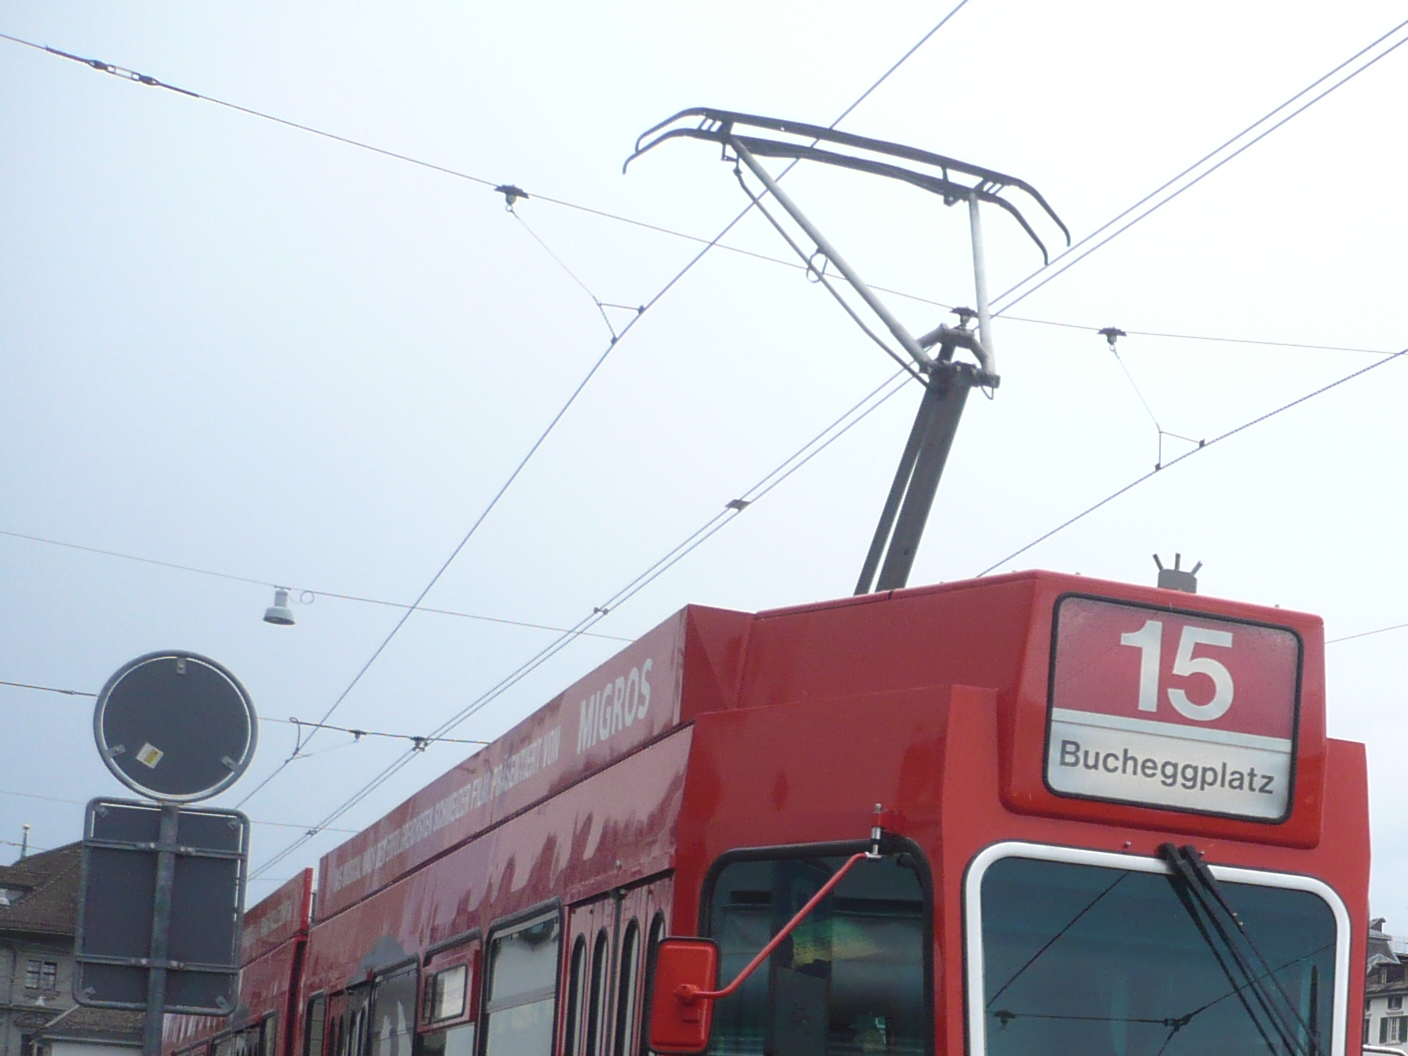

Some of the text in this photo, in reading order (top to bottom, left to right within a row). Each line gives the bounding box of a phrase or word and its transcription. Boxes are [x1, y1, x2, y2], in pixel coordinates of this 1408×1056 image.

[576, 657, 654, 755] MIGROS
[1120, 620, 1235, 721] 15
[1058, 739, 1275, 795] Bucheggplatz
